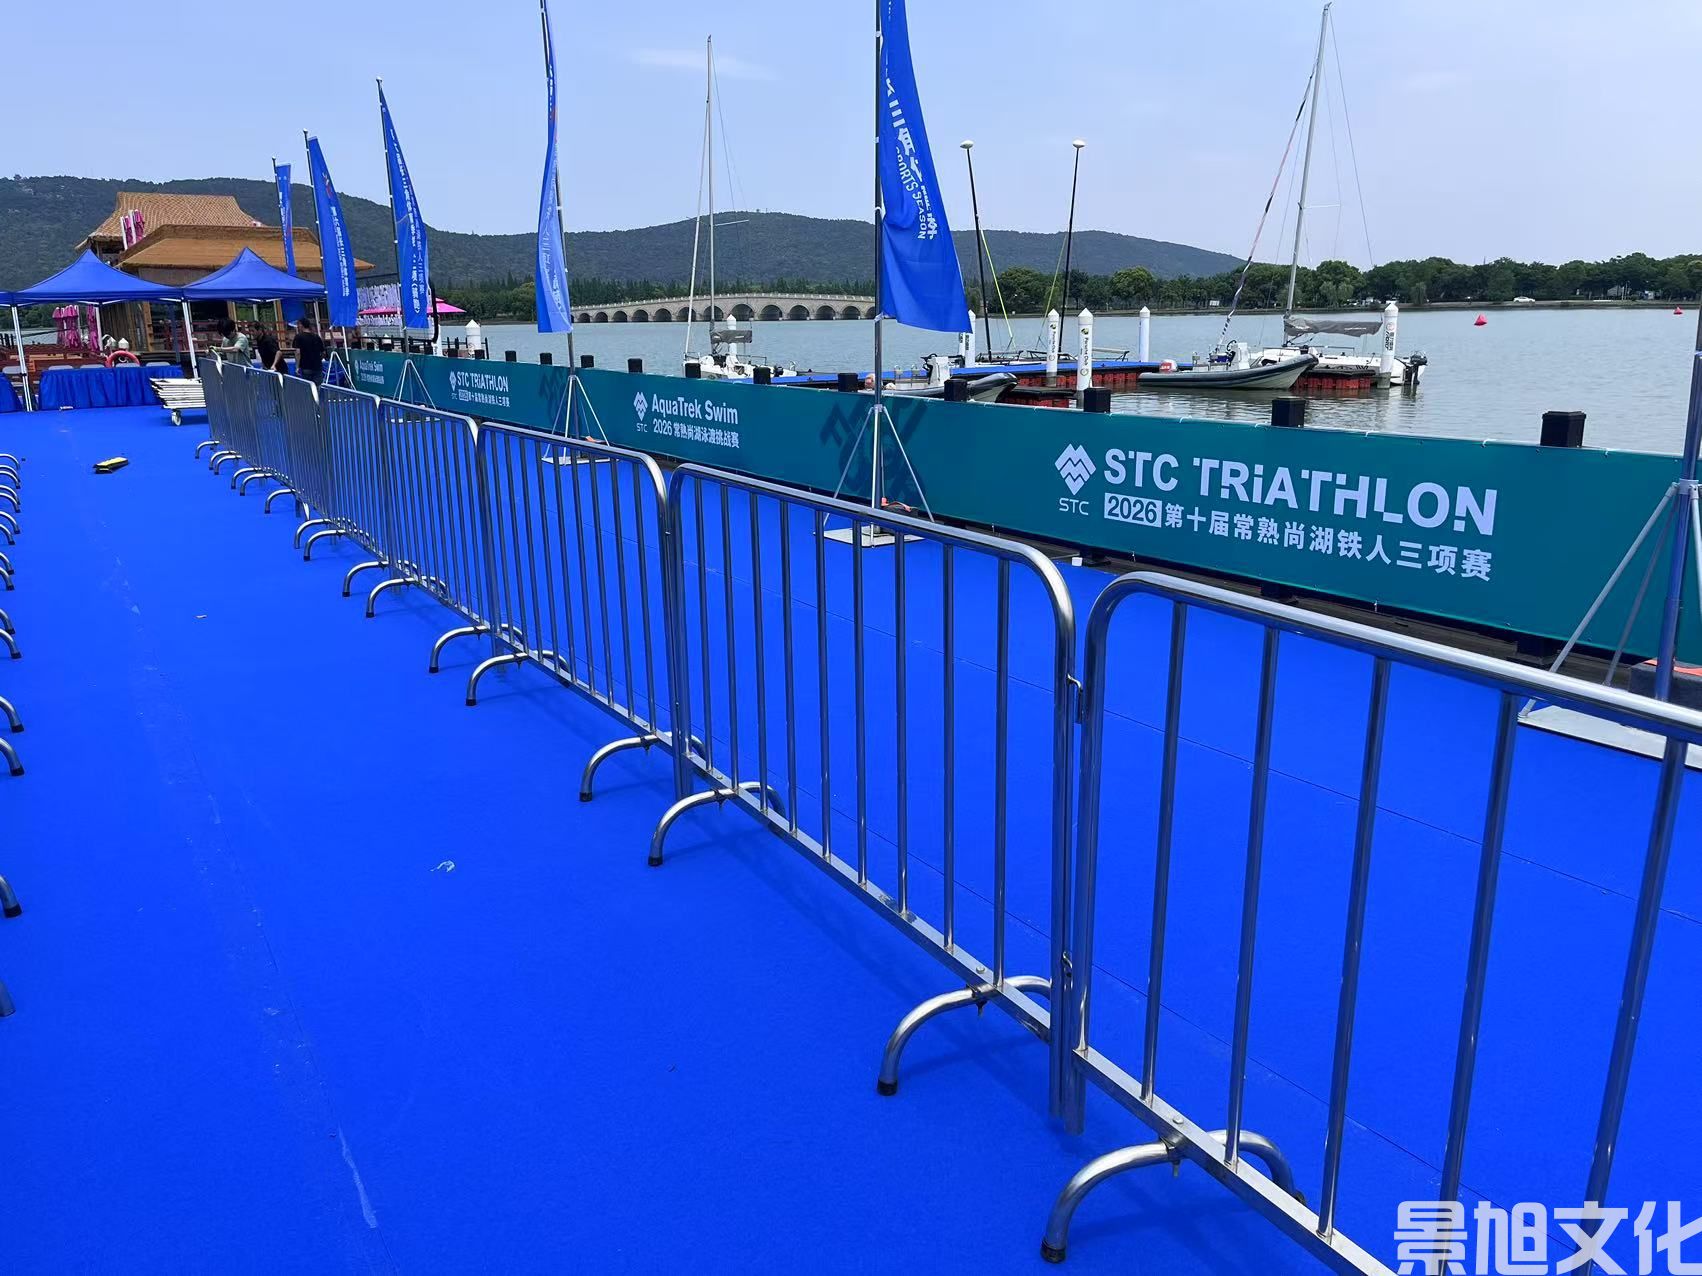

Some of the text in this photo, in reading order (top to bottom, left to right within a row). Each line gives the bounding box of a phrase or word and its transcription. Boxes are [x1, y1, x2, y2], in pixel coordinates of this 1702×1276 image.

[912, 191, 926, 240] SEASON
[457, 371, 470, 388] STC
[652, 394, 739, 425] AquaTrek Swim
[636, 422, 648, 433] STC
[652, 418, 673, 436] 2026
[1104, 448, 1179, 492] STC
[1059, 497, 1090, 516] STC
[1106, 495, 1493, 582] 2026 第十届常熟尚湖铁人三项赛
